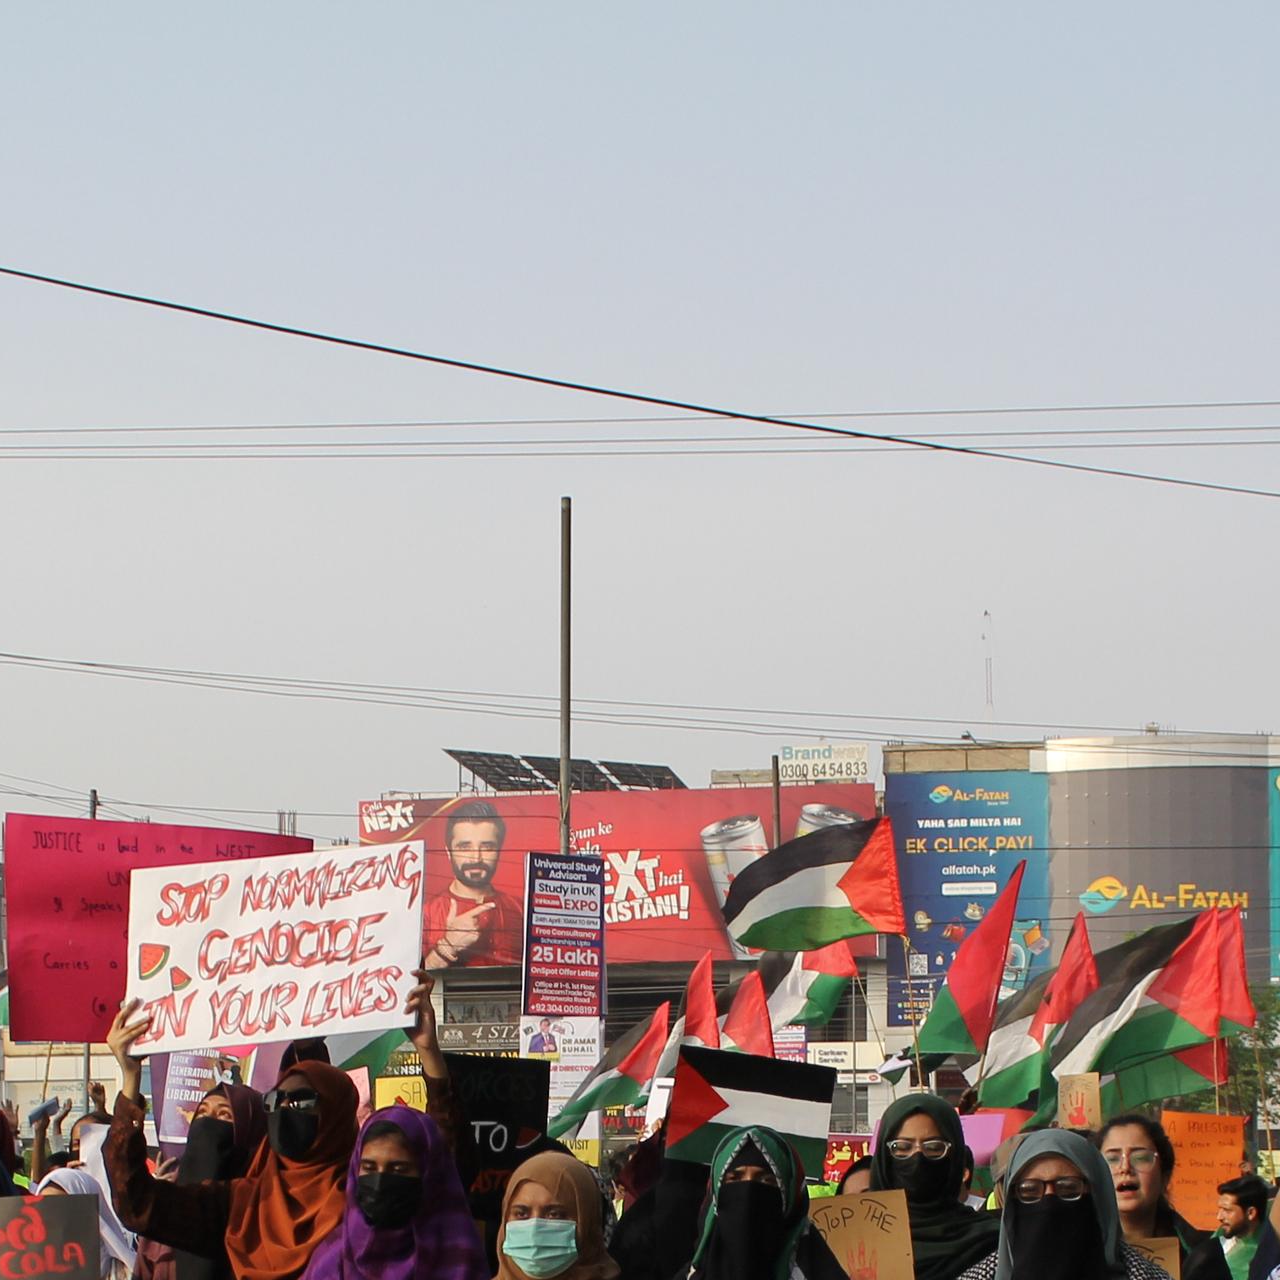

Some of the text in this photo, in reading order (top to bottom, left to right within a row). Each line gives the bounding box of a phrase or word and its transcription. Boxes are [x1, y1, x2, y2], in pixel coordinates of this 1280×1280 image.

[953, 789, 1009, 801] AL-FATAH
[362, 802, 415, 834] NEXT
[906, 836, 1033, 854] EK CLICK PAY!
[534, 859, 601, 875] Universal Study
[549, 870, 587, 881] Advisors
[942, 864, 997, 877] alfatah.pk
[156, 844, 422, 927] STOP NORMALIZING
[539, 883, 596, 897] Study in UK
[564, 898, 598, 912] EXPO
[1130, 883, 1249, 909] AL-FATAH
[198, 911, 388, 987] GENOCIDE
[532, 946, 598, 966] 25 Lakh
[209, 981, 298, 1041] YOUR
[301, 965, 404, 1030] LIVES
[471, 1120, 508, 1152] TO
[860, 1198, 898, 1234] THE
